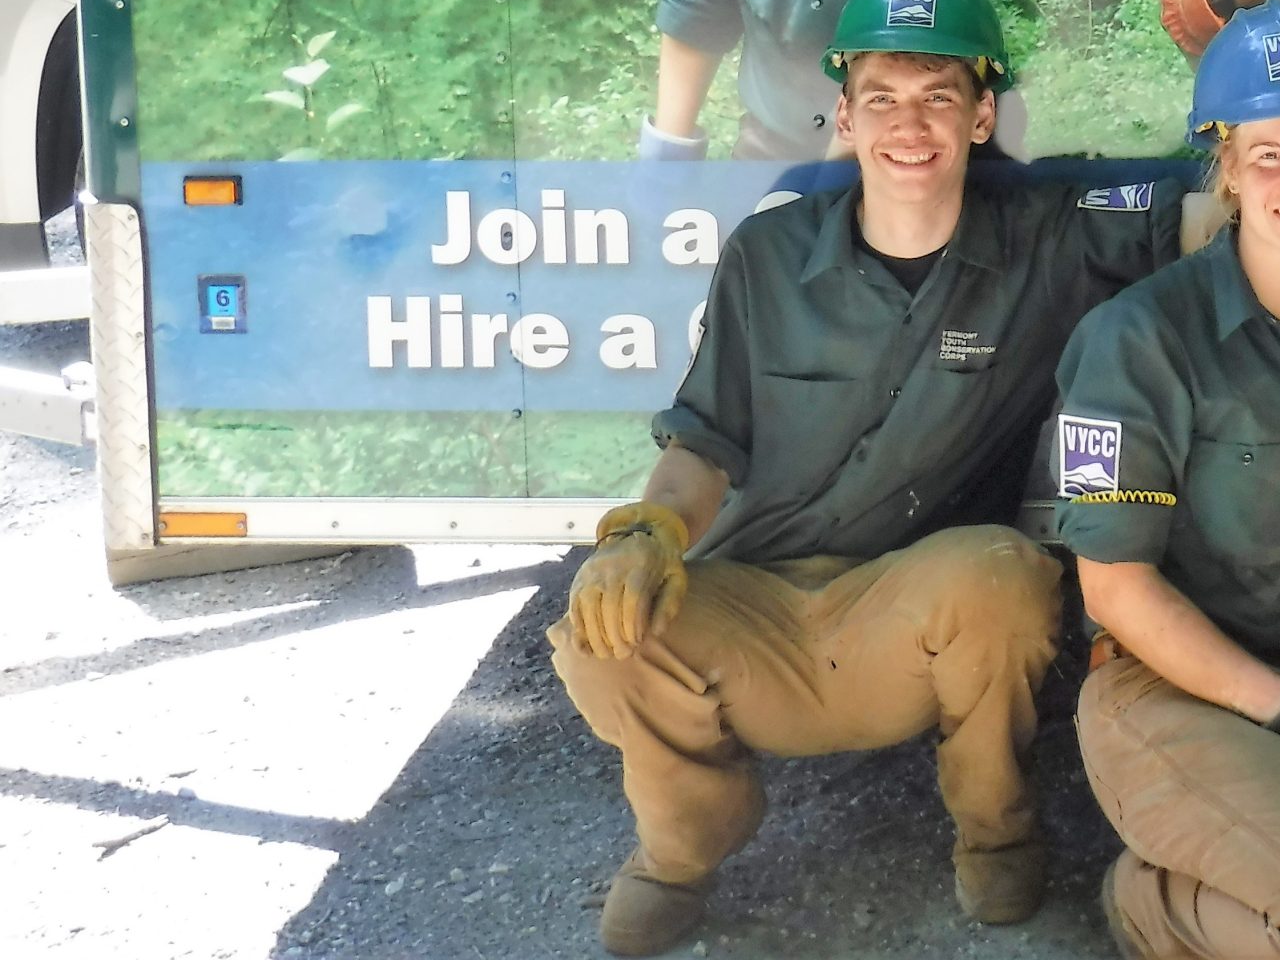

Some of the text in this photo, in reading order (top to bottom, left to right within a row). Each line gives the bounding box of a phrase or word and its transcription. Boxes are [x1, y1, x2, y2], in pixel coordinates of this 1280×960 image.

[431, 189, 719, 265] Join a
[216, 289, 230, 307] 6
[367, 294, 570, 369] Hire
[600, 313, 657, 369] a
[940, 352, 967, 361] CORPS
[1065, 425, 1116, 458] VYCC
